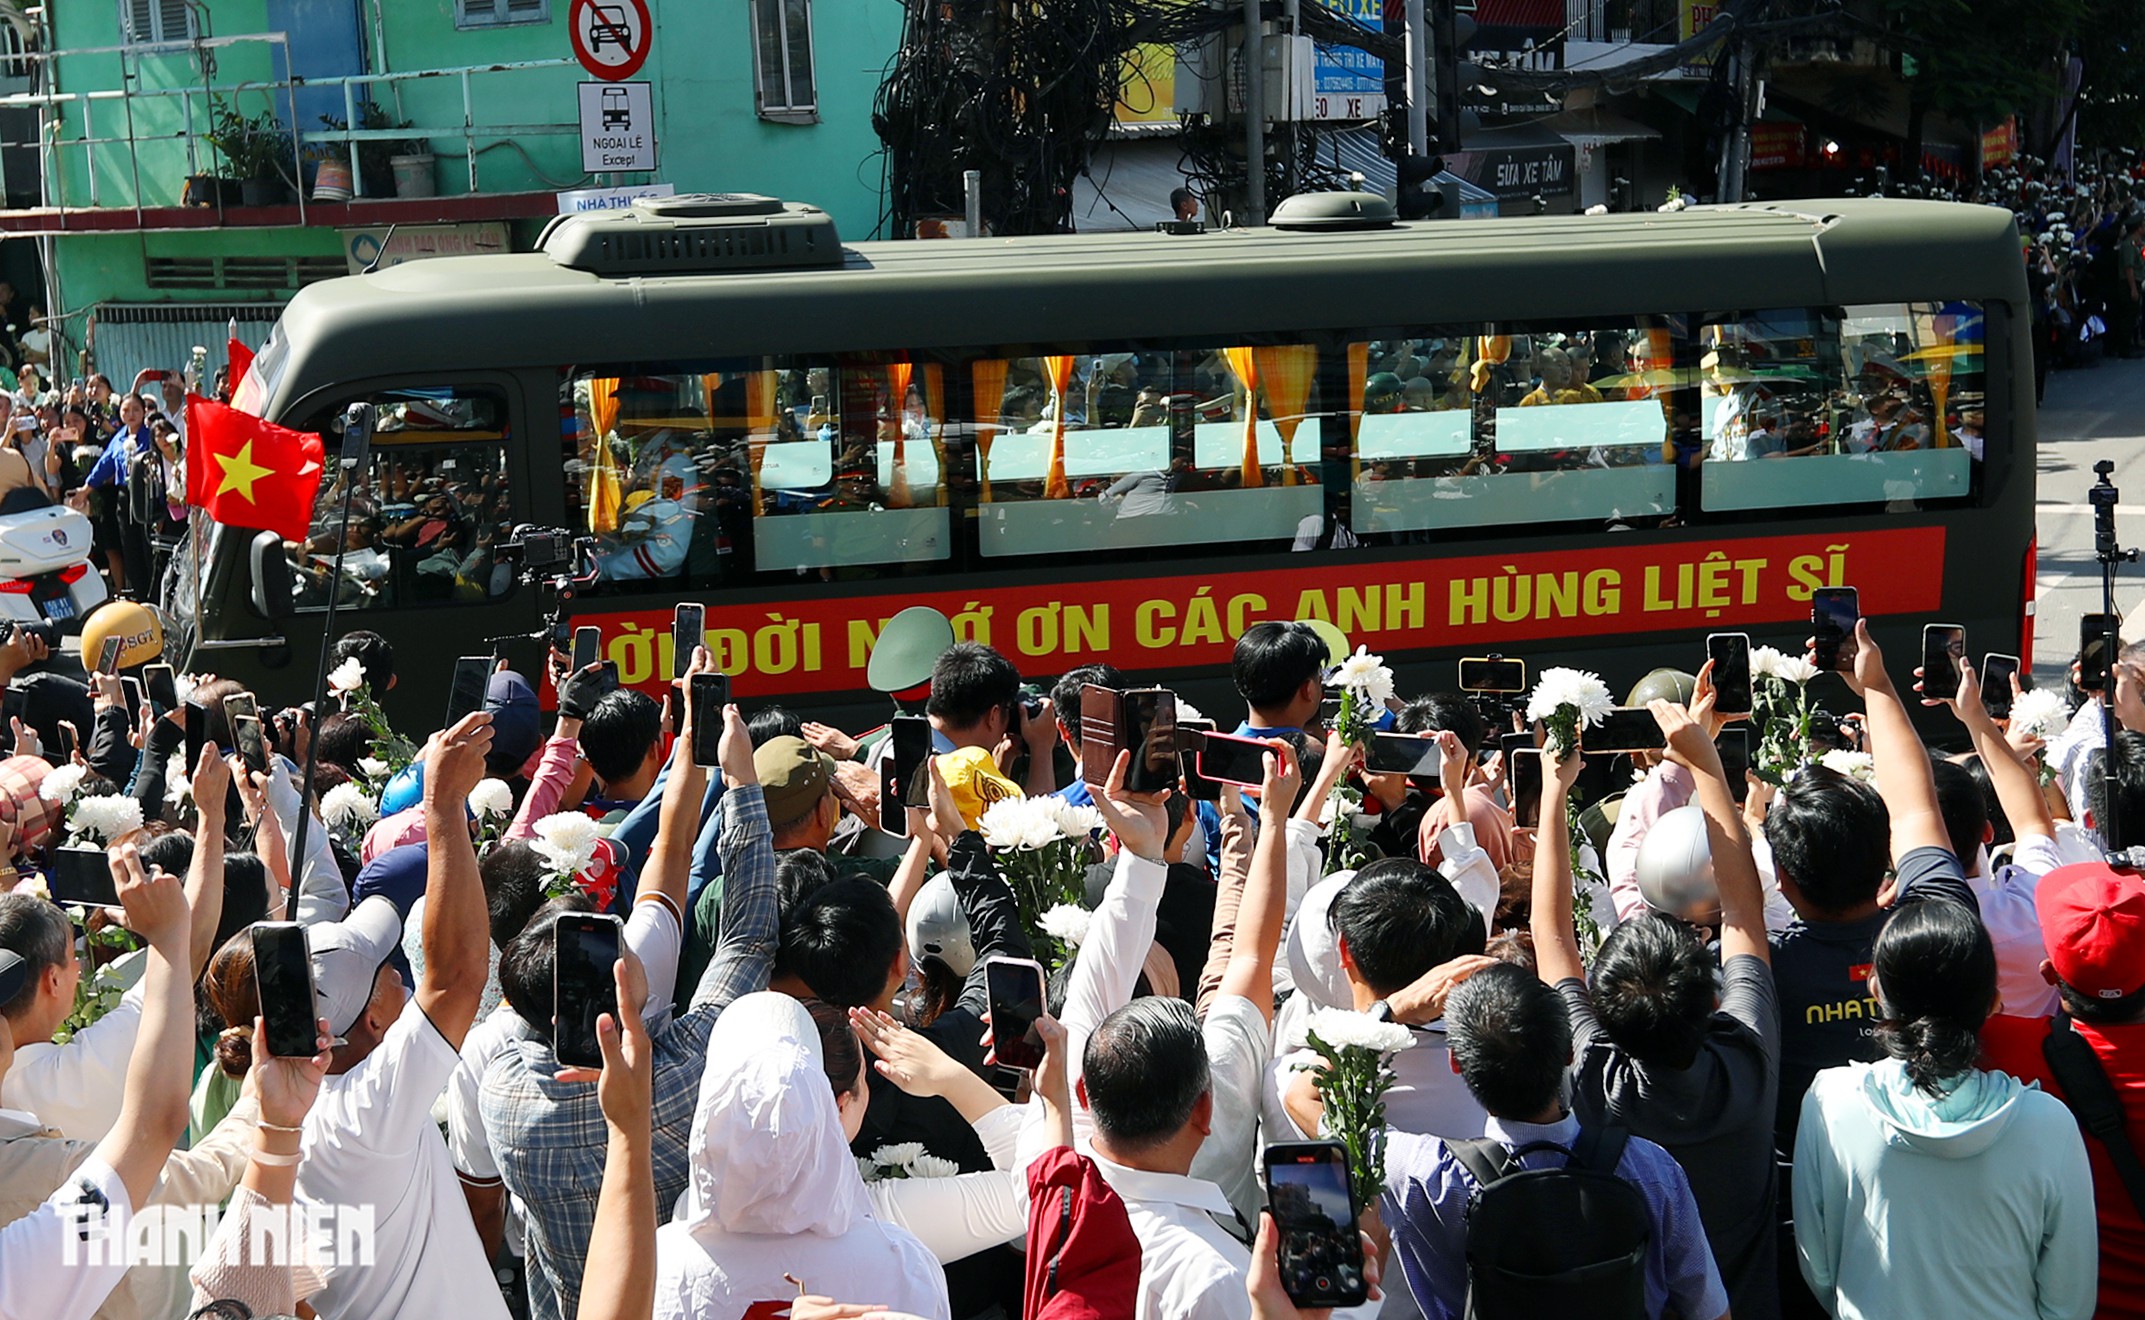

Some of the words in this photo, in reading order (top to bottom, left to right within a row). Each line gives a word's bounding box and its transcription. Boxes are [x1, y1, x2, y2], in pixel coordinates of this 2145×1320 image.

[1347, 98, 1361, 118] XE
[593, 137, 627, 152] NGOẠI
[629, 134, 643, 152] LỆ
[602, 154, 635, 167] Except
[1497, 155, 1520, 187] SỬA
[1523, 162, 1540, 186] XE
[1542, 153, 1563, 183] TÂM
[577, 195, 607, 211] NHÀ
[704, 612, 821, 677] ĐỜI
[848, 601, 994, 669] NỚ
[1016, 602, 1110, 657] ƠN
[1135, 585, 1268, 649] CÁC
[1294, 582, 1425, 635] ANH
[1448, 564, 1621, 626] HÙNG
[1643, 550, 1767, 618] LIỆT
[1786, 543, 1850, 601] SĨ
